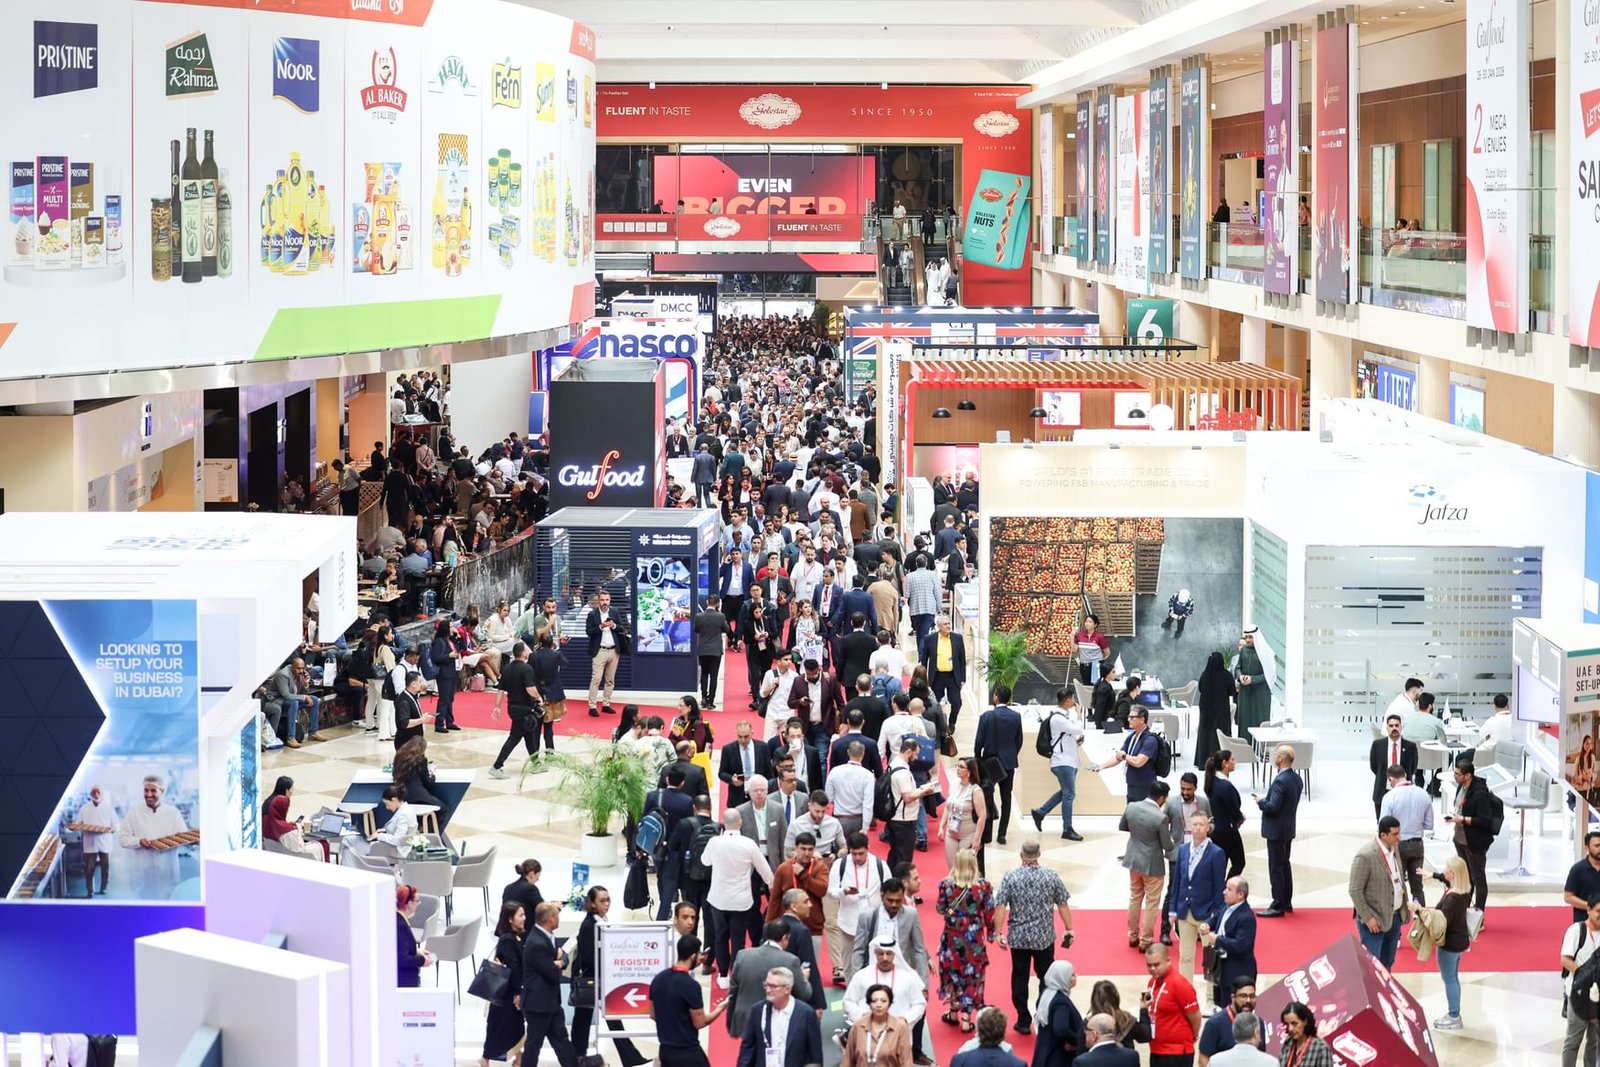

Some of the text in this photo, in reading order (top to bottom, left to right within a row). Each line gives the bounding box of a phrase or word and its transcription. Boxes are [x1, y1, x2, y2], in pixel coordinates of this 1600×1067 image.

[38, 44, 94, 69] PRISTINE
[168, 66, 215, 88] Rahma
[495, 71, 520, 100] Fern
[366, 88, 404, 108] AL BAKER
[606, 106, 691, 116] FLUENT IN TASTE
[752, 103, 788, 116] Golestan
[851, 107, 934, 117] SINCE 1950
[1474, 103, 1507, 153] 2 MEGA
[1483, 137, 1507, 153] VENUES
[42, 163, 64, 173] PRISTINE
[737, 178, 793, 193] EVEN
[43, 195, 63, 204] MULTI
[973, 215, 995, 228] NUTS
[661, 303, 693, 312] DMCC
[1137, 308, 1164, 347] 6
[600, 334, 697, 359] nasco
[558, 450, 646, 500] Gulfood
[1418, 503, 1469, 526] Jafza
[100, 643, 183, 656] LOOKING TO
[96, 658, 183, 670] SETUP YOUR
[113, 672, 183, 684] BUSINESS
[1576, 665, 1592, 678] UAE
[115, 686, 183, 698] IN DUBAI?
[613, 958, 660, 966] REGISTER
